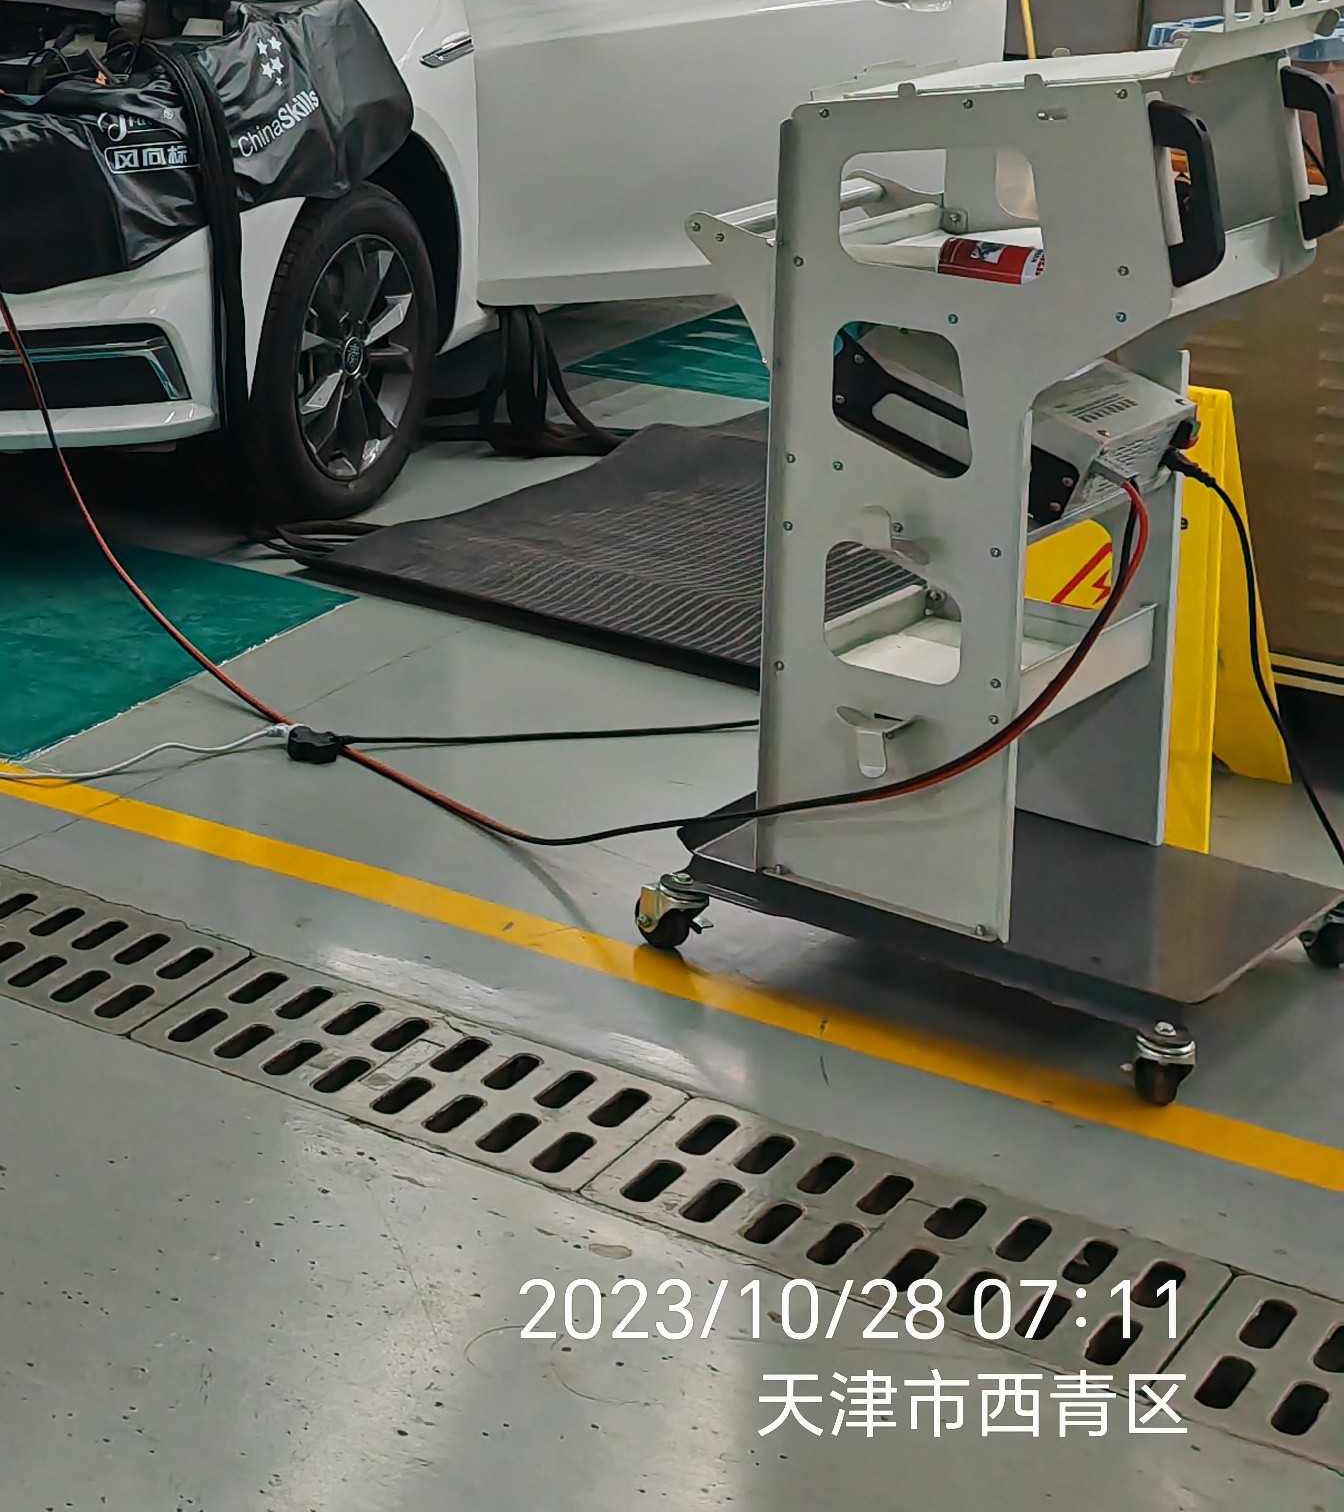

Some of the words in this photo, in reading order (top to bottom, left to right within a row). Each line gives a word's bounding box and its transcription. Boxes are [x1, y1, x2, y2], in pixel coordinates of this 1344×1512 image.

[237, 89, 320, 158] ChinaSkills
[114, 145, 188, 170] 风向标
